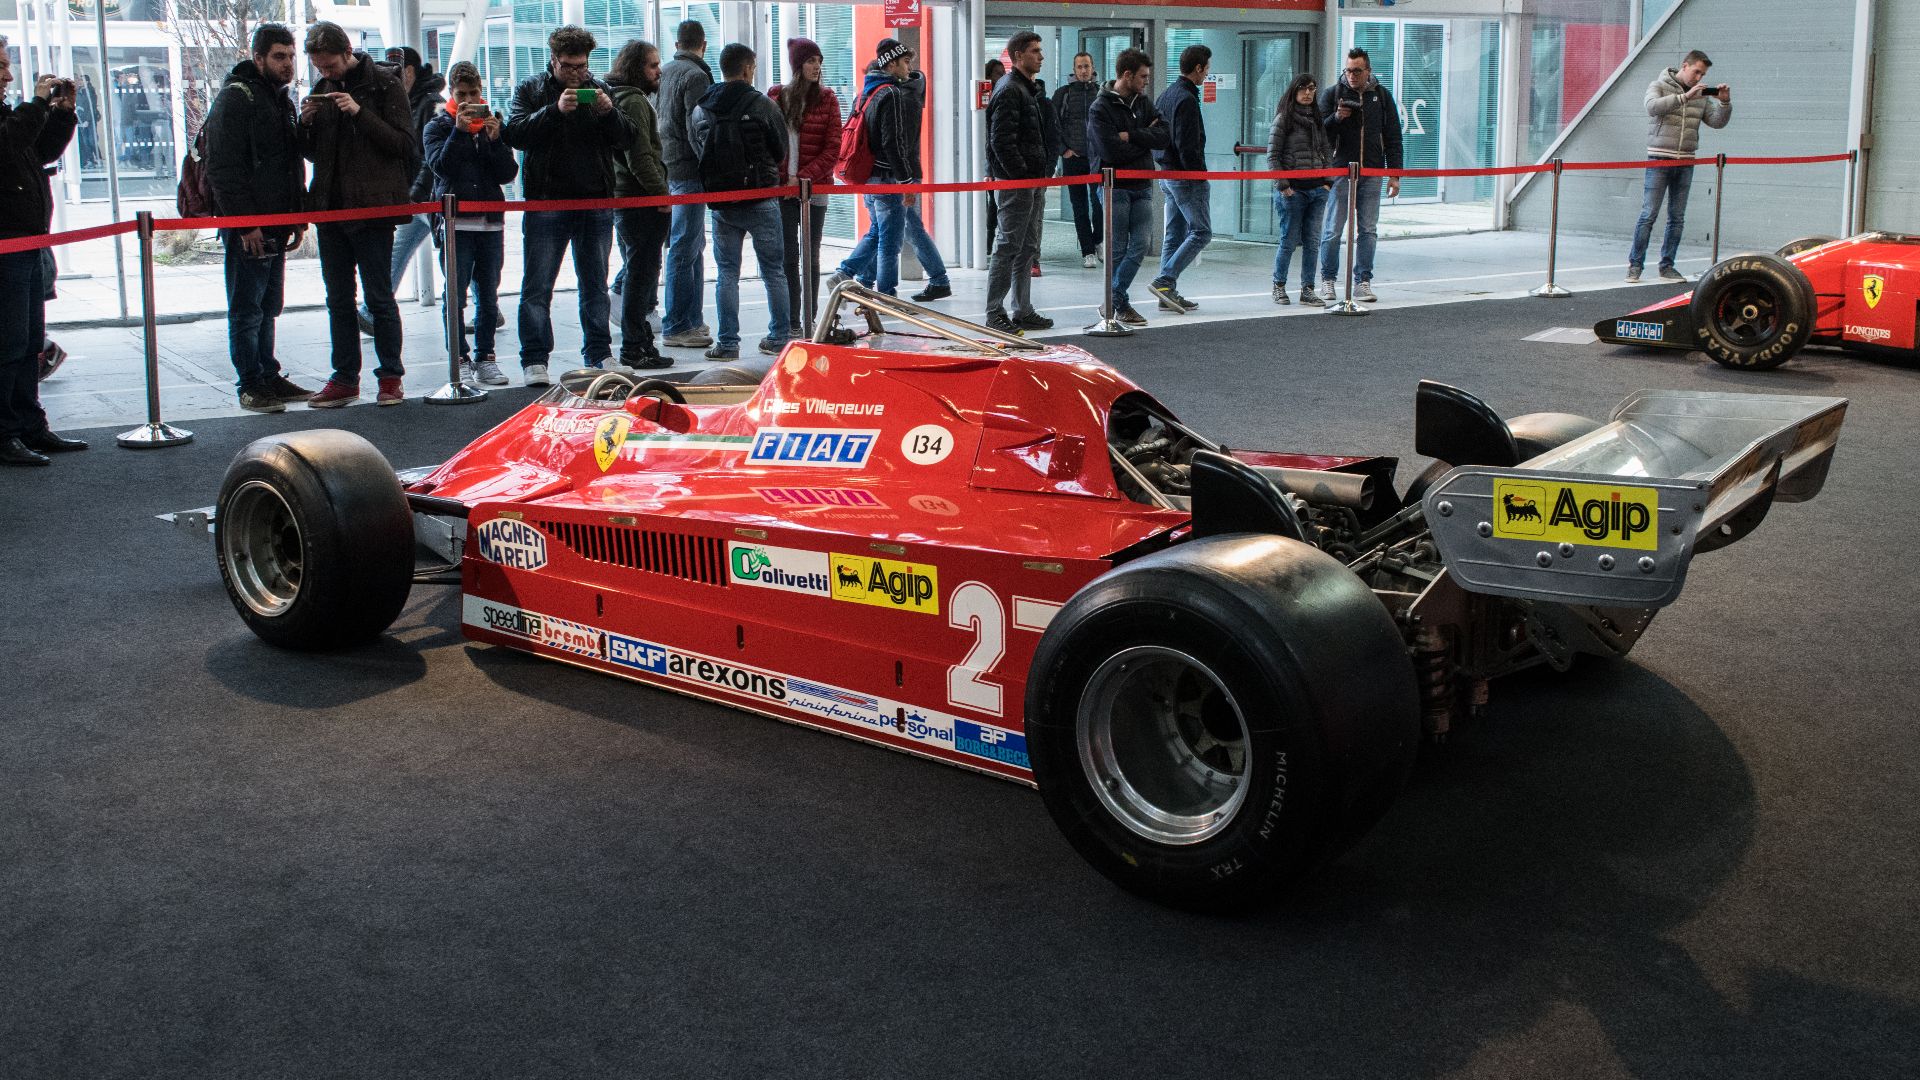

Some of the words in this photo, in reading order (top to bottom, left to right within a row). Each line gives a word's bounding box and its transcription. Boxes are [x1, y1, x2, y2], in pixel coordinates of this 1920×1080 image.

[1714, 260, 1763, 280] EAGLE
[1617, 321, 1662, 339] digital
[1844, 324, 1891, 339] LONGINES
[806, 399, 885, 416] Villeneuve
[756, 434, 871, 461] FIAT
[912, 434, 943, 455] 134
[1548, 487, 1650, 541] Agip
[480, 521, 546, 557] MAGNETI
[480, 535, 546, 569] MARELLI
[762, 568, 829, 591] olivetti
[868, 561, 933, 606] Agip
[483, 605, 541, 636] speedline
[612, 639, 666, 669] SKF
[668, 653, 787, 700] arexons
[787, 697, 880, 726] pininfarina
[879, 713, 953, 741] pesonal
[1259, 751, 1287, 839] MICHELIN
[1210, 857, 1242, 880] TRX
